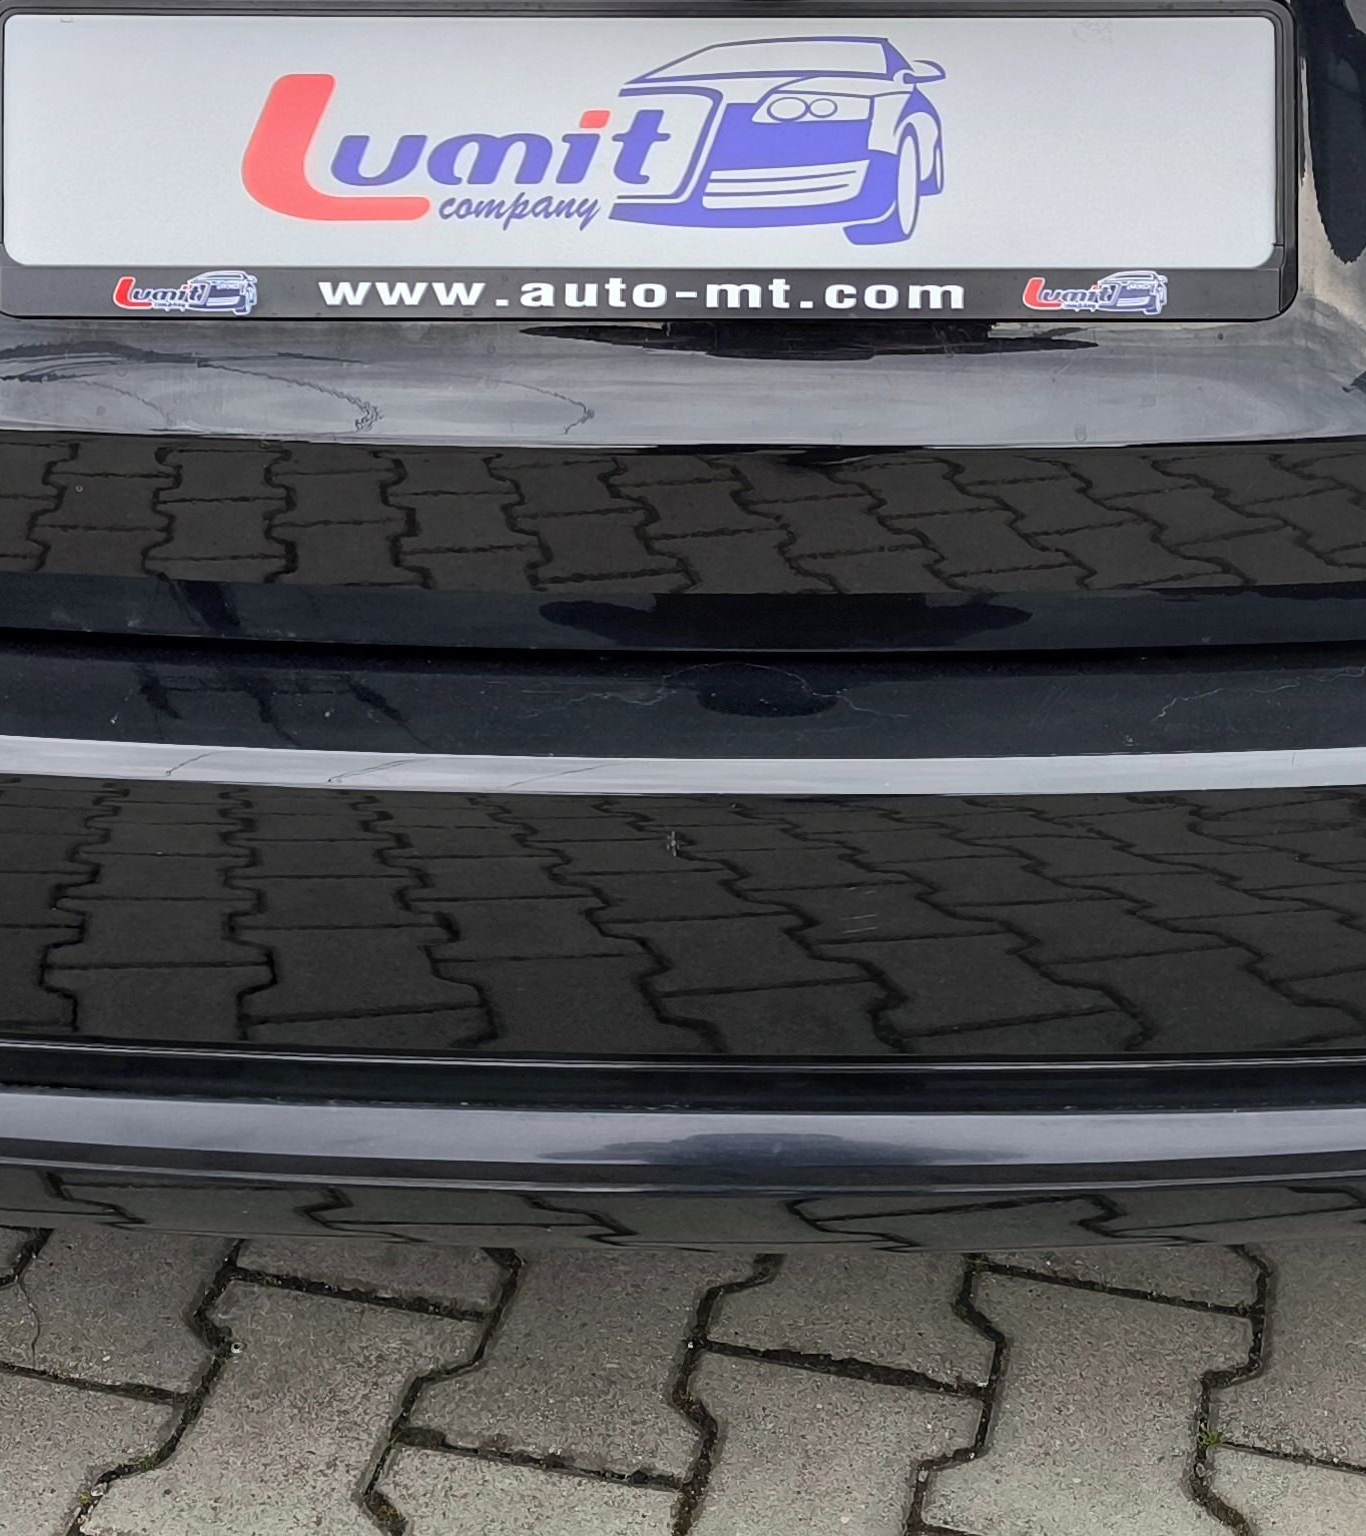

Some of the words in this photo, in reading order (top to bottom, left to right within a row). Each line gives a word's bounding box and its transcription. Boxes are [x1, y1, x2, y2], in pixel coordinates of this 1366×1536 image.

[242, 73, 671, 221] Lumit
[439, 192, 601, 231] company
[113, 276, 205, 309] Lumit
[318, 277, 966, 310] www.auto-mt.com
[1023, 277, 1112, 310] Lumit
